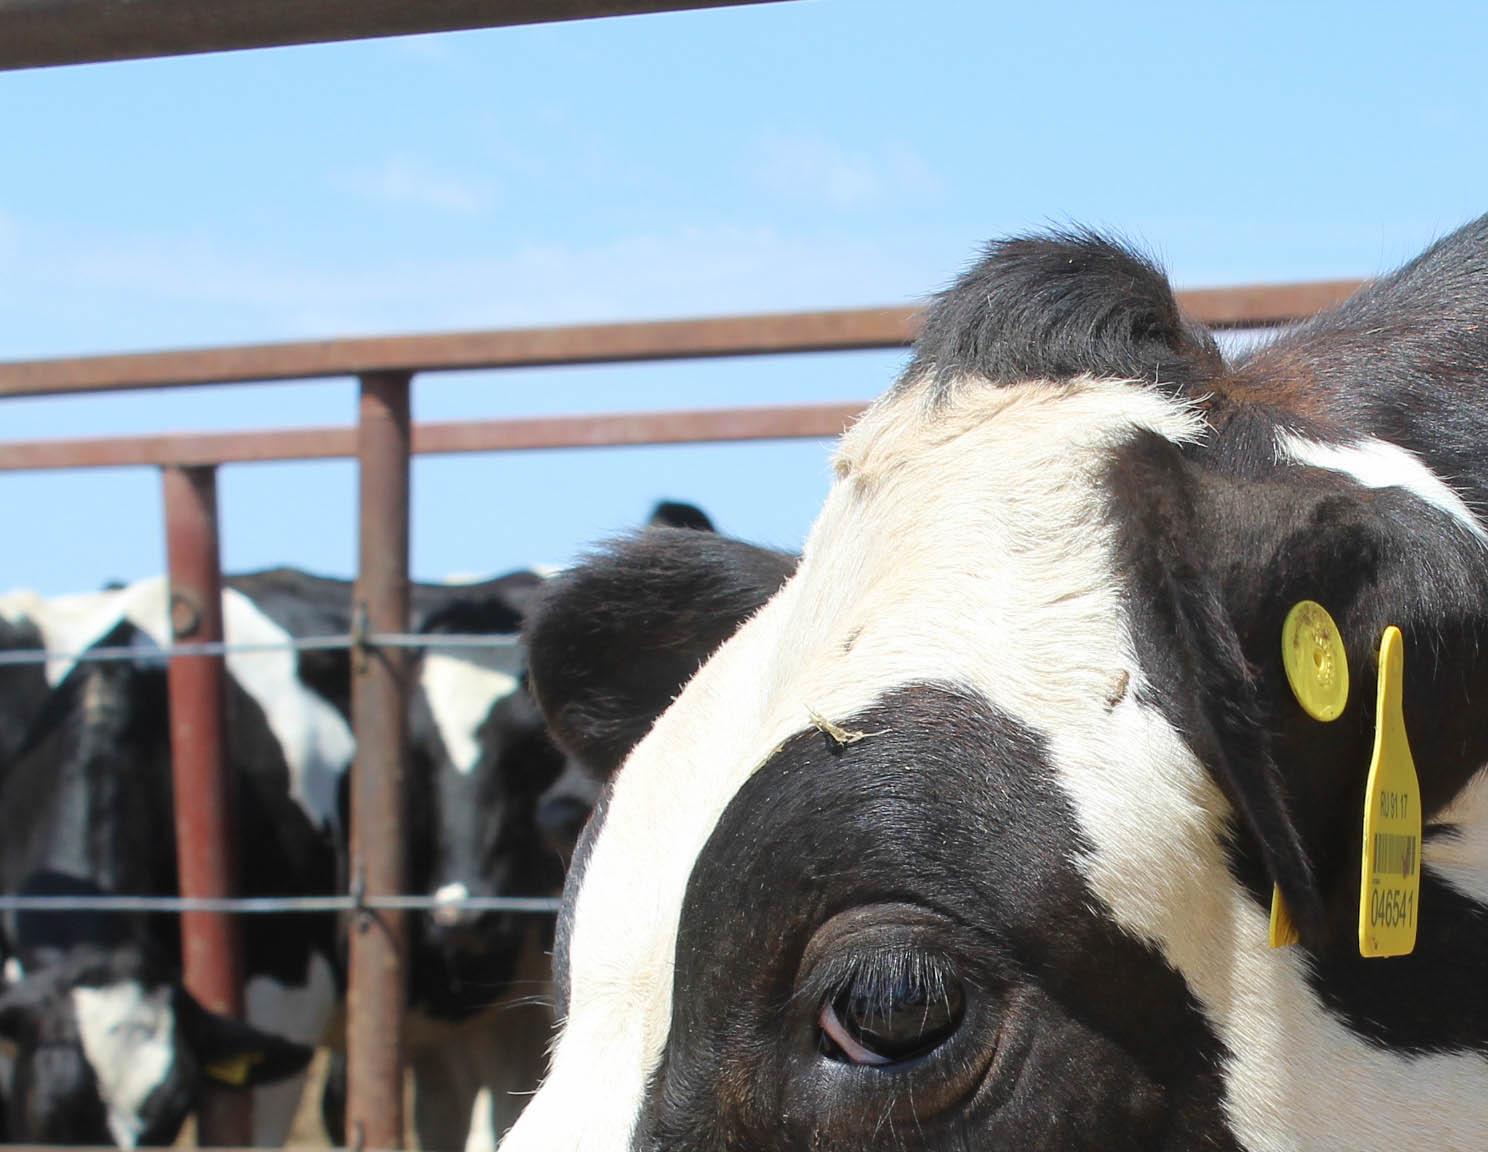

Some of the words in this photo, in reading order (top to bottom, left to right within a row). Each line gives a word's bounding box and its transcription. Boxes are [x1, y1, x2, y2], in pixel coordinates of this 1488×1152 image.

[1380, 791, 1389, 818] RU
[1400, 793, 1408, 819] 17
[1371, 888, 1414, 928] 046541
